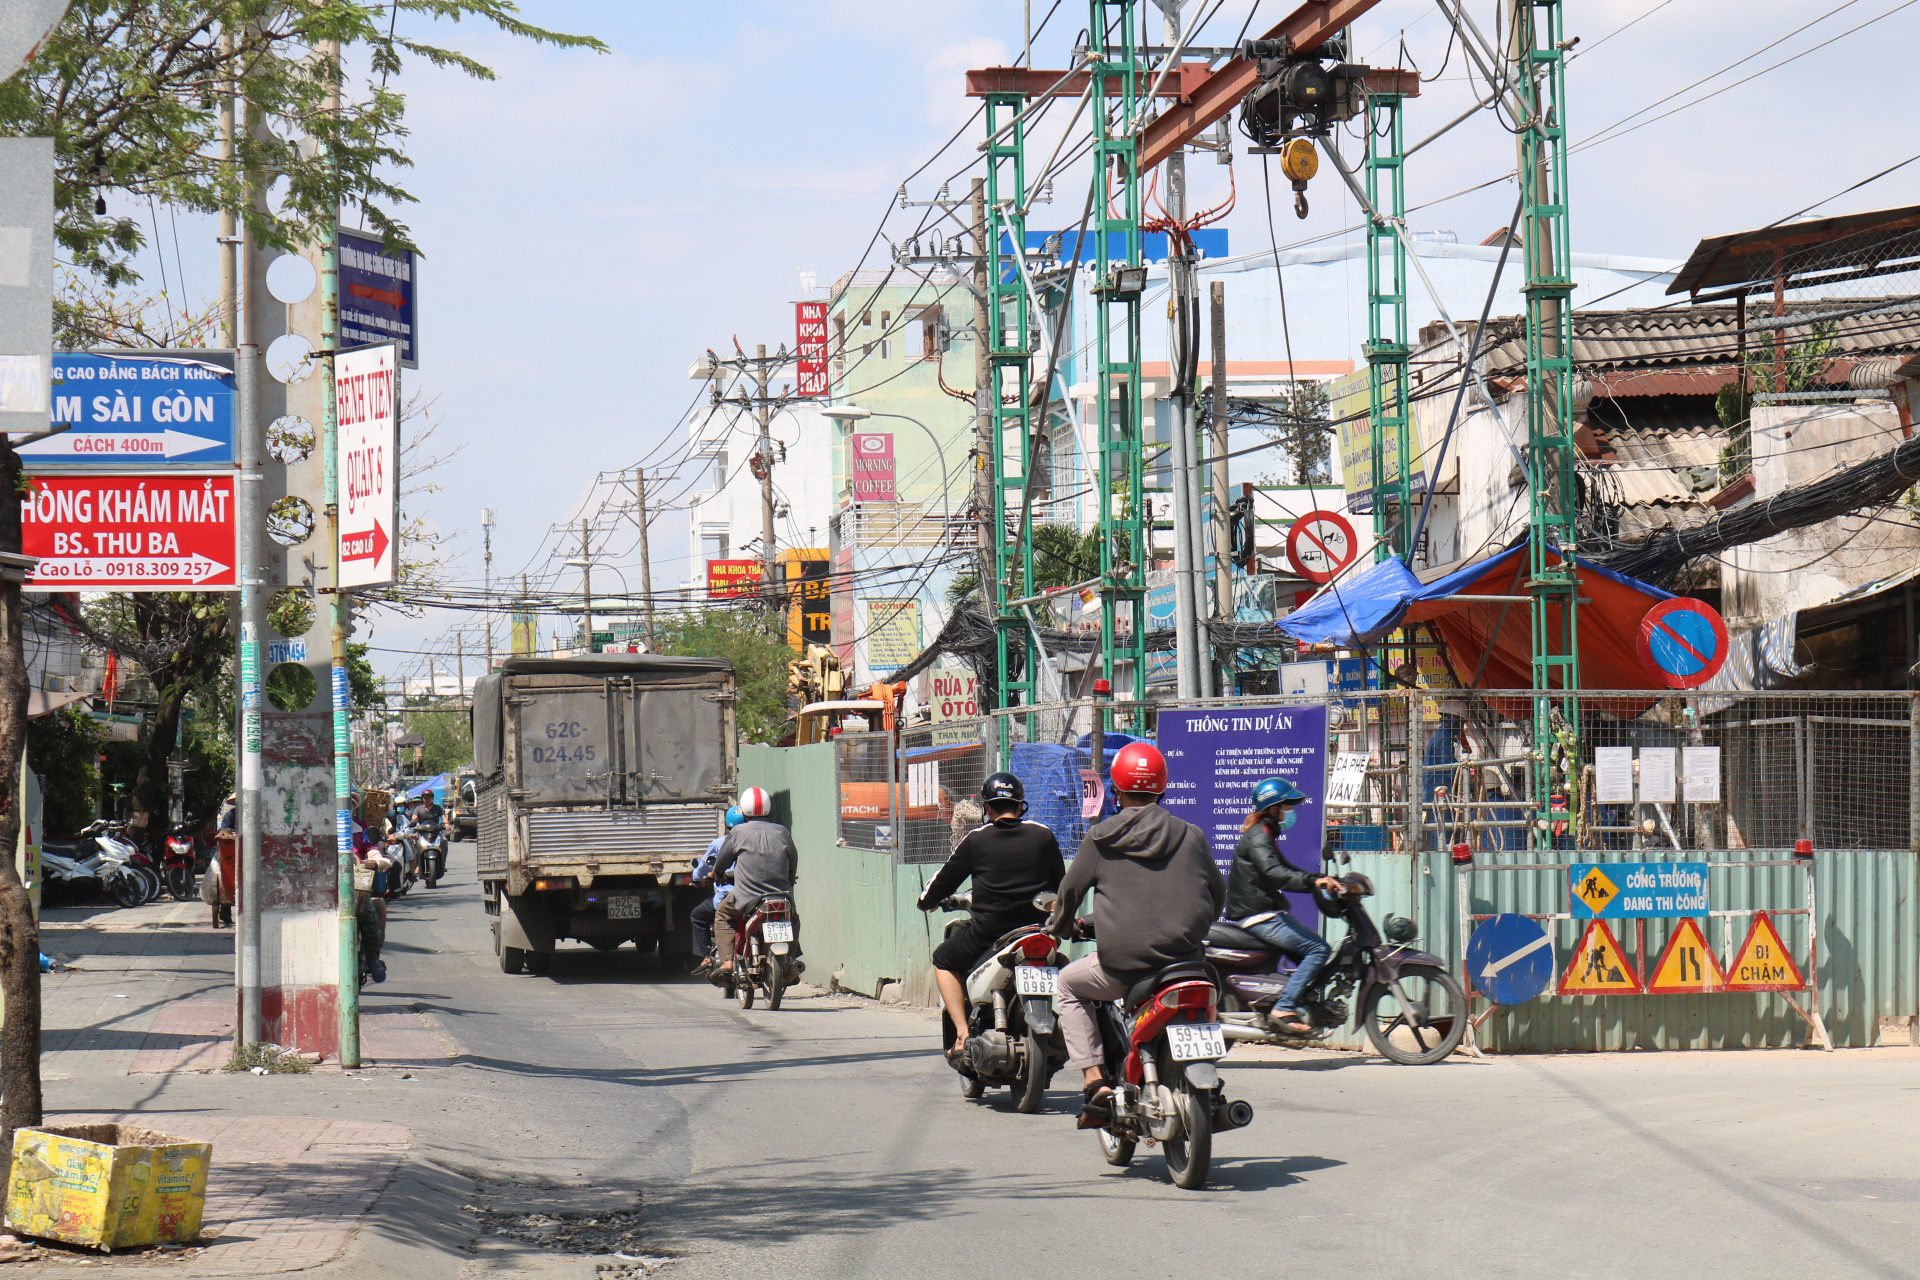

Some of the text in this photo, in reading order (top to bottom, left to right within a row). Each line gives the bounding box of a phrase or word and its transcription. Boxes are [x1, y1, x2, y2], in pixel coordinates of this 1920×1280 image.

[802, 305, 821, 319] NHA
[800, 323, 825, 337] KHOA
[67, 367, 95, 380] CAO
[99, 361, 138, 380] ĐẲNG
[142, 362, 179, 380] BÁCH
[337, 356, 393, 437] BỆNH VIỆN
[91, 389, 142, 422] SÀI
[152, 389, 214, 423] GÒN
[73, 435, 163, 452] CÁCH 400m
[377, 445, 382, 495] 8
[855, 458, 893, 472] MORNING
[855, 479, 894, 493] COFFEE
[21, 478, 229, 523] HÒNG KHÁM MẮT
[54, 532, 179, 554] BS. THU BA
[342, 540, 350, 556] 82
[351, 538, 364, 555] CAO
[40, 563, 69, 576] Cao
[74, 559, 92, 576] Lỗ
[106, 562, 179, 577] 0918.309
[183, 562, 212, 577] 257
[712, 565, 746, 575] NHA KHOA
[934, 671, 962, 697] RỬA
[941, 697, 977, 717] ÔTÔ
[1186, 712, 1292, 733] THÔNG TIN DỰ ÁN
[532, 745, 596, 764] 024.45
[1254, 747, 1276, 755] TRƯỜNG
[1276, 746, 1292, 755] NƯỚC
[1254, 757, 1264, 765] TÀU
[1279, 767, 1295, 776] ĐOẠN
[1083, 779, 1098, 798] 570
[1213, 807, 1224, 815] CÁC
[1224, 806, 1240, 815] CÔNG
[1215, 833, 1235, 841] NIPPON
[1626, 865, 1702, 889] CÔNG TRƯỜNG
[1624, 893, 1706, 911] ĐANG THI CÔNG
[1755, 945, 1769, 960] ĐI
[1740, 963, 1785, 984] CHẬM
[1023, 981, 1054, 993] 0982
[1175, 1026, 1213, 1042] 59-L1
[1174, 1041, 1222, 1058] 321.90
